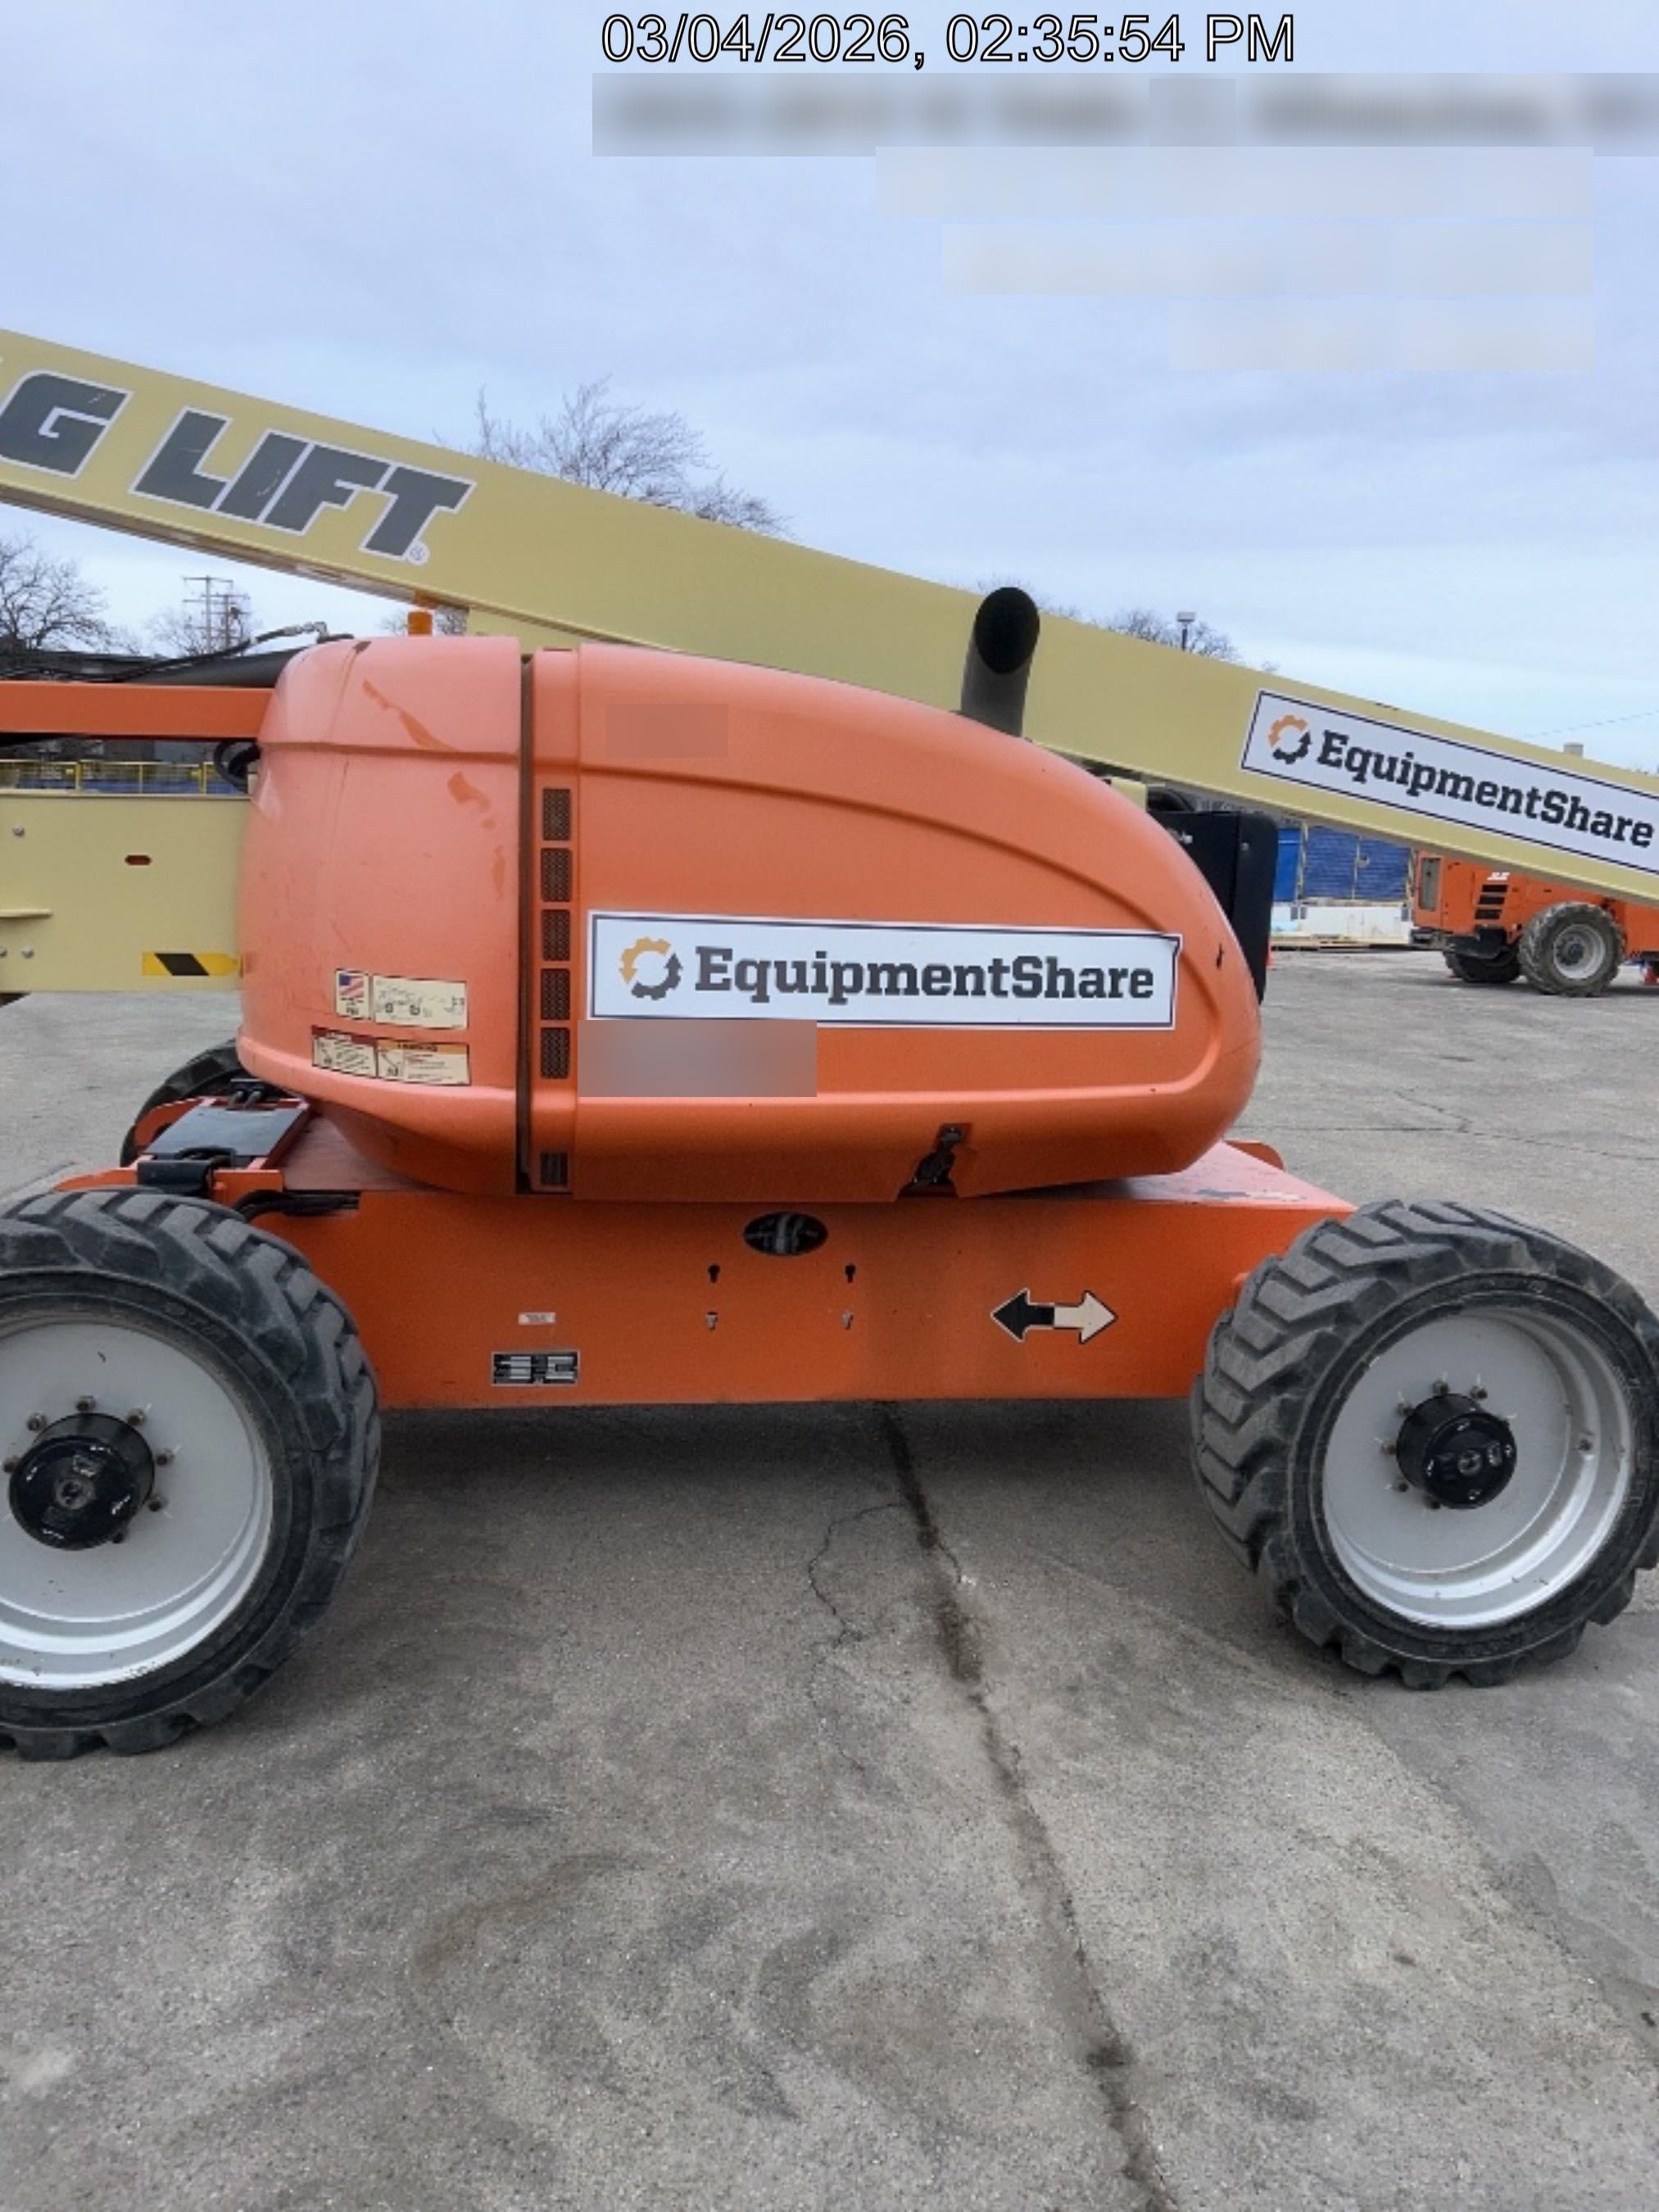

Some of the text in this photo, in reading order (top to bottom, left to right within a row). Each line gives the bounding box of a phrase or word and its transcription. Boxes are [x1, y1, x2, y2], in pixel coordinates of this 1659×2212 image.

[127, 406, 477, 562] LIFT
[1317, 729, 1654, 848] EquipmentShare
[694, 945, 1154, 1006] EquipmentShare
